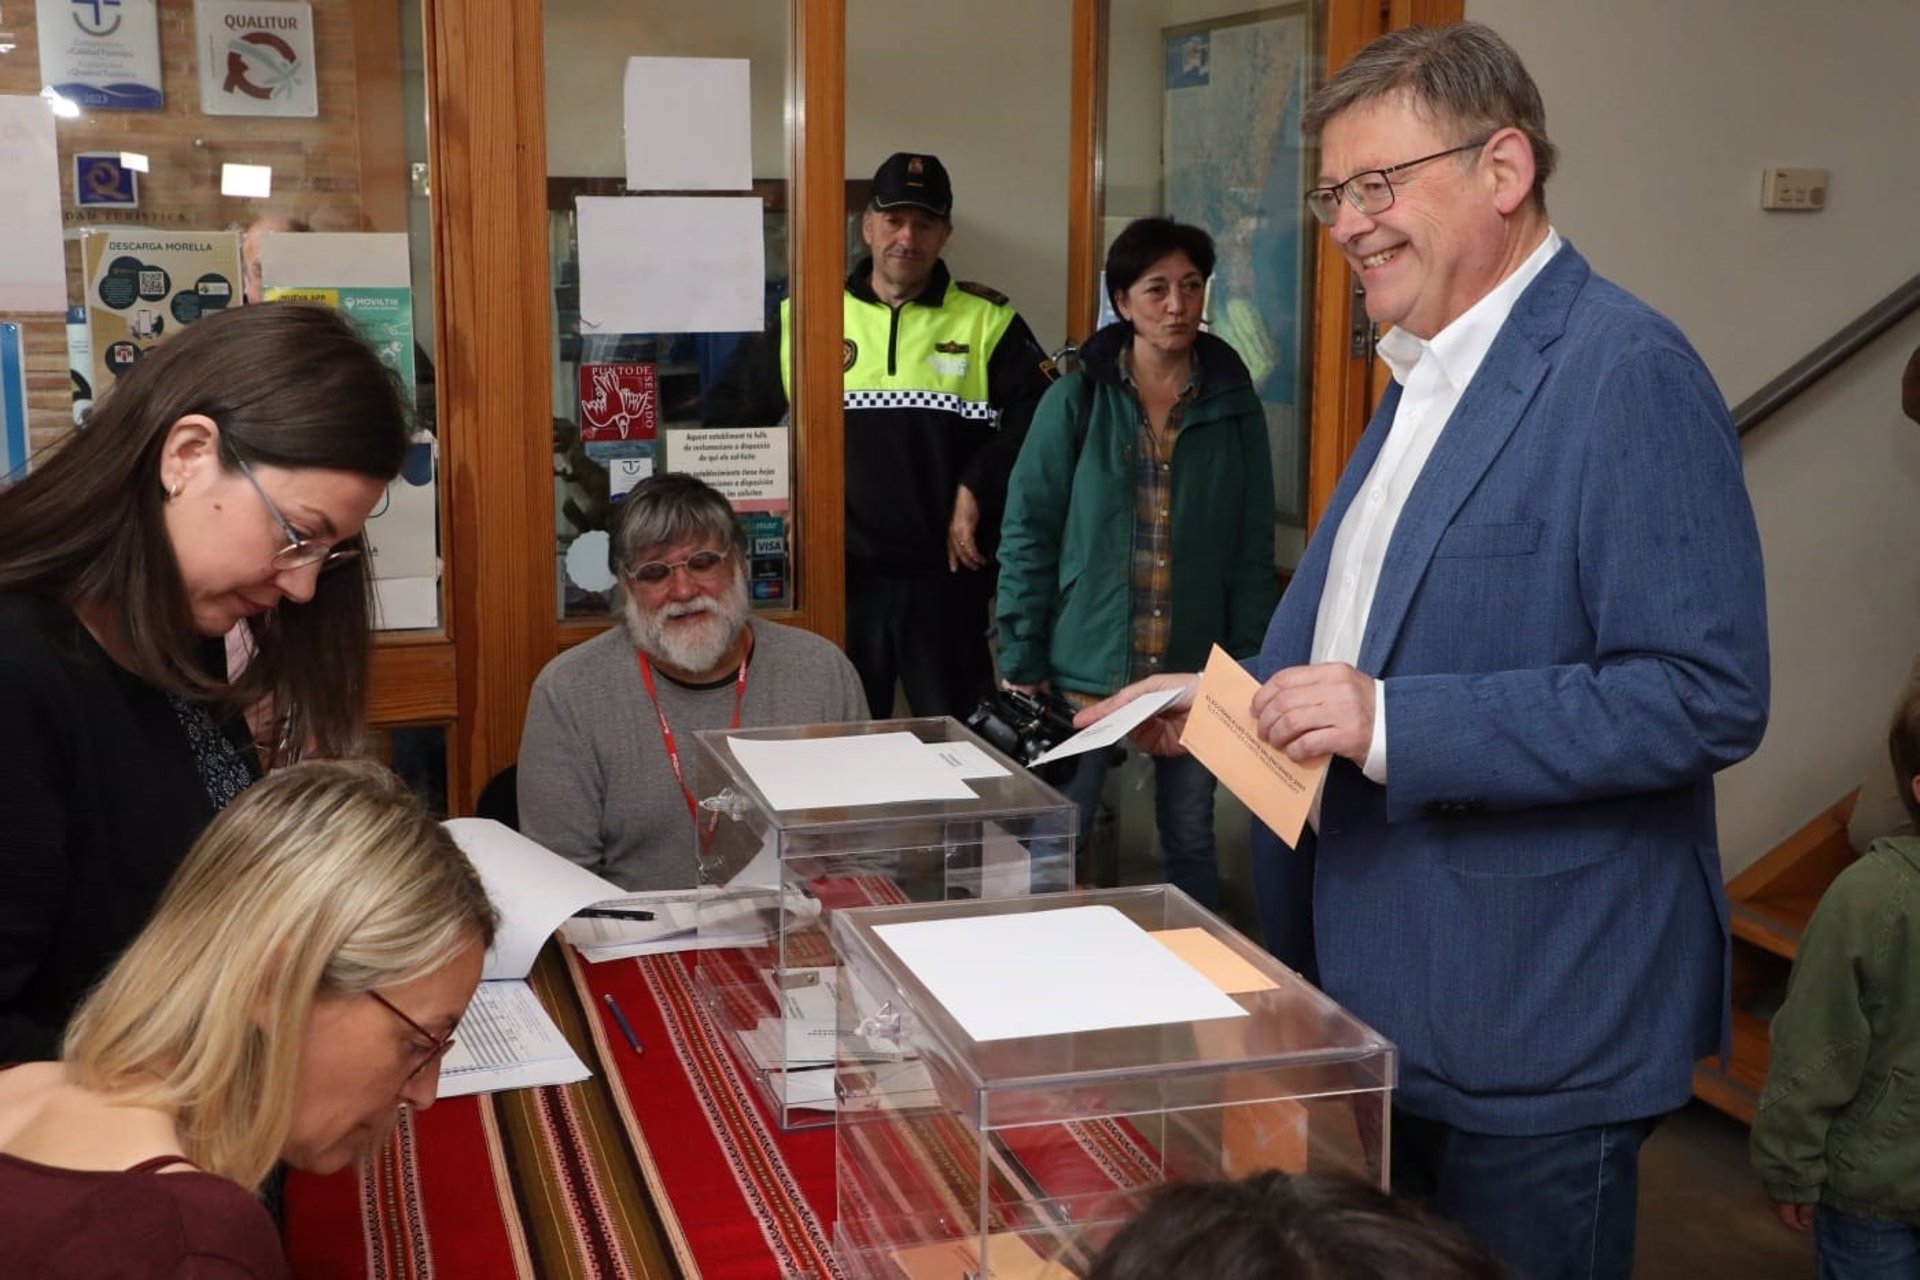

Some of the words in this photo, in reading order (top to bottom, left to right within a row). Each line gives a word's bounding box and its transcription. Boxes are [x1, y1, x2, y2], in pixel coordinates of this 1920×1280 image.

[224, 14, 297, 30] QUALITUR
[109, 242, 162, 251] DESCARGA
[165, 242, 212, 252] MORELLA
[636, 366, 652, 376] DE
[759, 468, 775, 477] hojas
[758, 541, 781, 551] VISA
